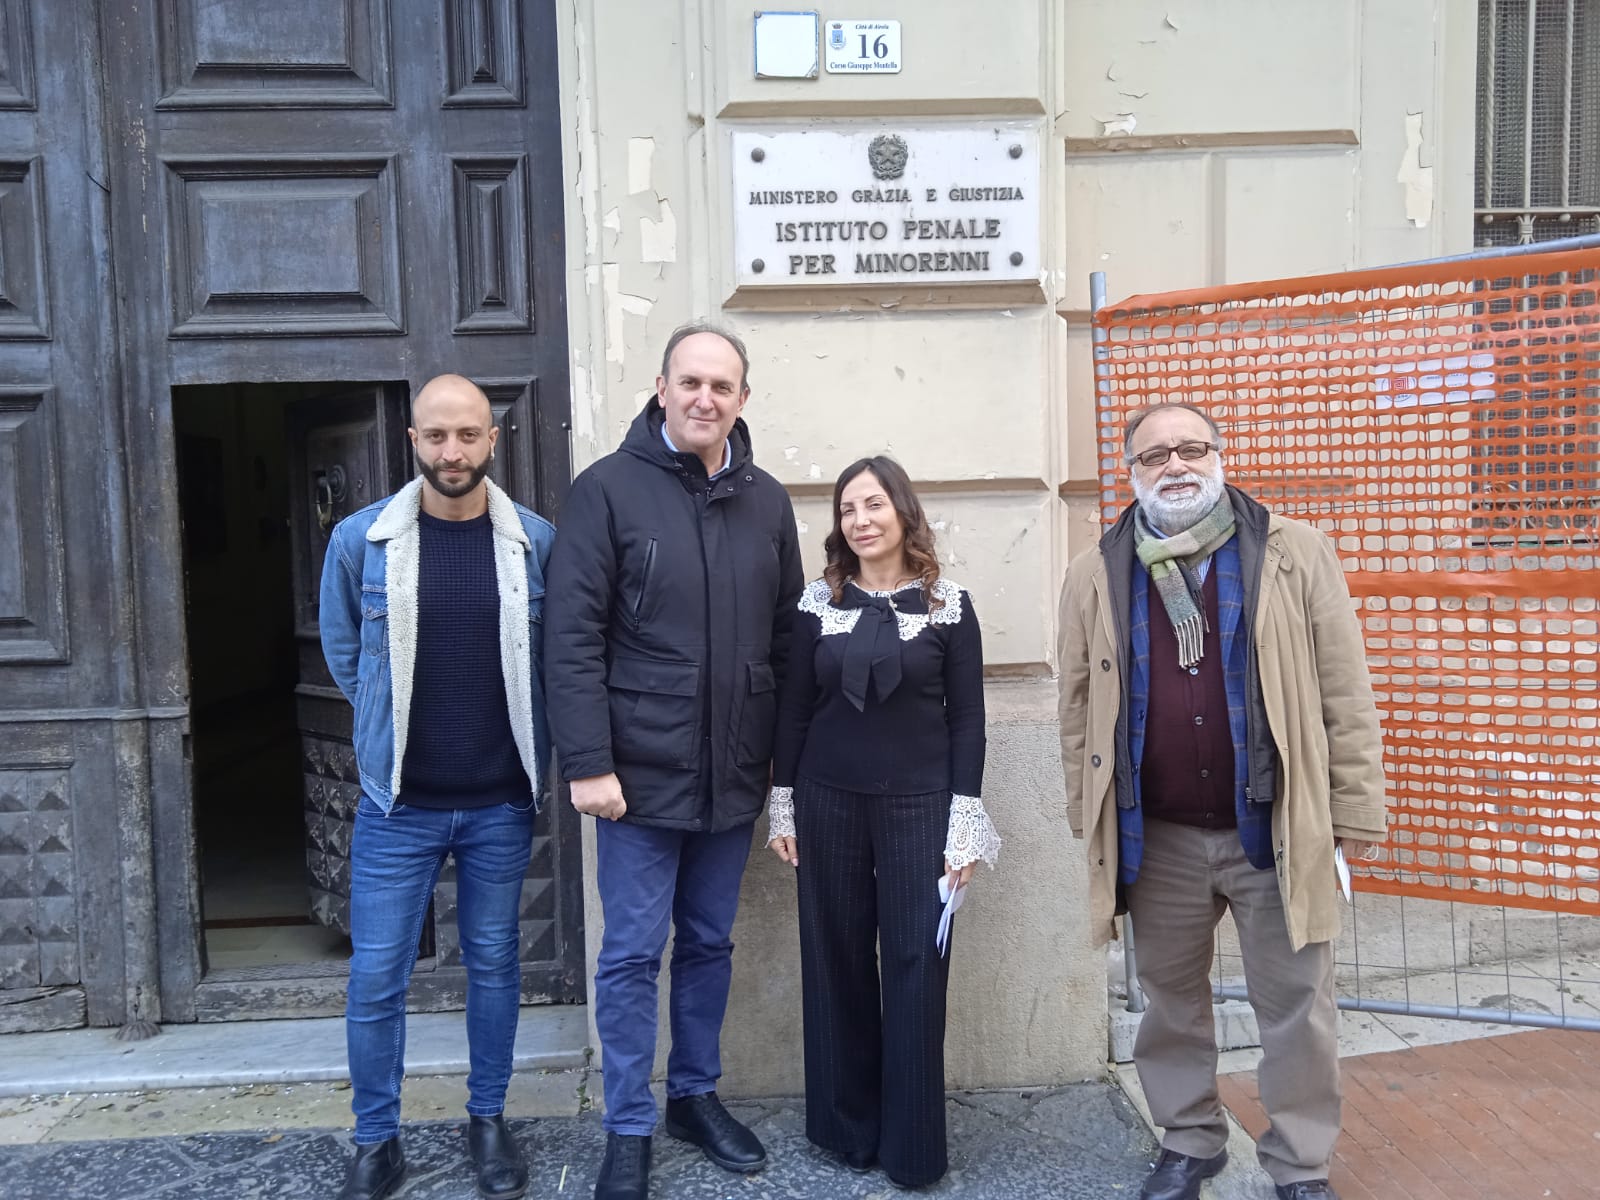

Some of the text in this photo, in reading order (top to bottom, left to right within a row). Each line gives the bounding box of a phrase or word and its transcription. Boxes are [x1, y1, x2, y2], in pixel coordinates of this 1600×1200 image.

[857, 34, 889, 59] 16
[830, 61, 846, 69] Corso
[847, 61, 873, 71] Giuseppe
[749, 186, 1024, 205] MINISTERO GRAZIA E GIUSTIZIA
[775, 218, 1001, 242] ISTITUTO PENALE
[789, 251, 990, 275] PER MINORENNI
